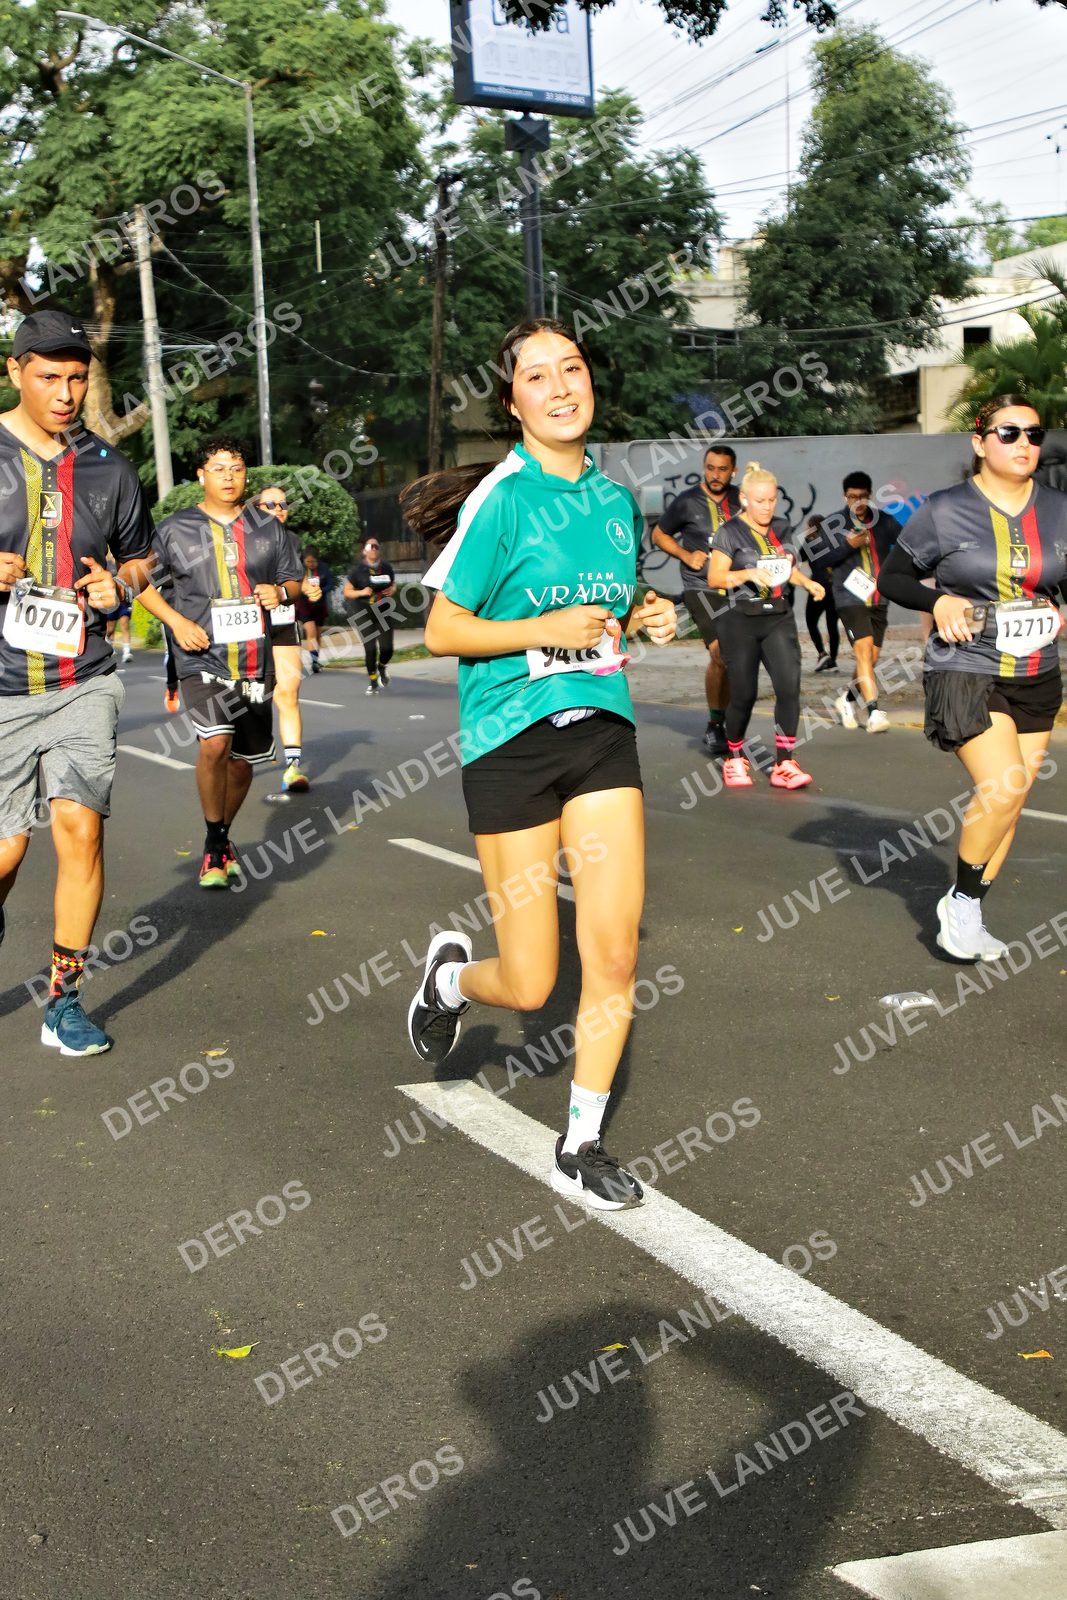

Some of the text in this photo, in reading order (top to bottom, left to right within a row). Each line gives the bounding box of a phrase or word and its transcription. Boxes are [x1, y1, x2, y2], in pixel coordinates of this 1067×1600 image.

[578, 572, 614, 581] TEAM
[14, 602, 79, 633] 10707
[217, 609, 259, 627] 12833
[1002, 616, 1054, 638] 12717
